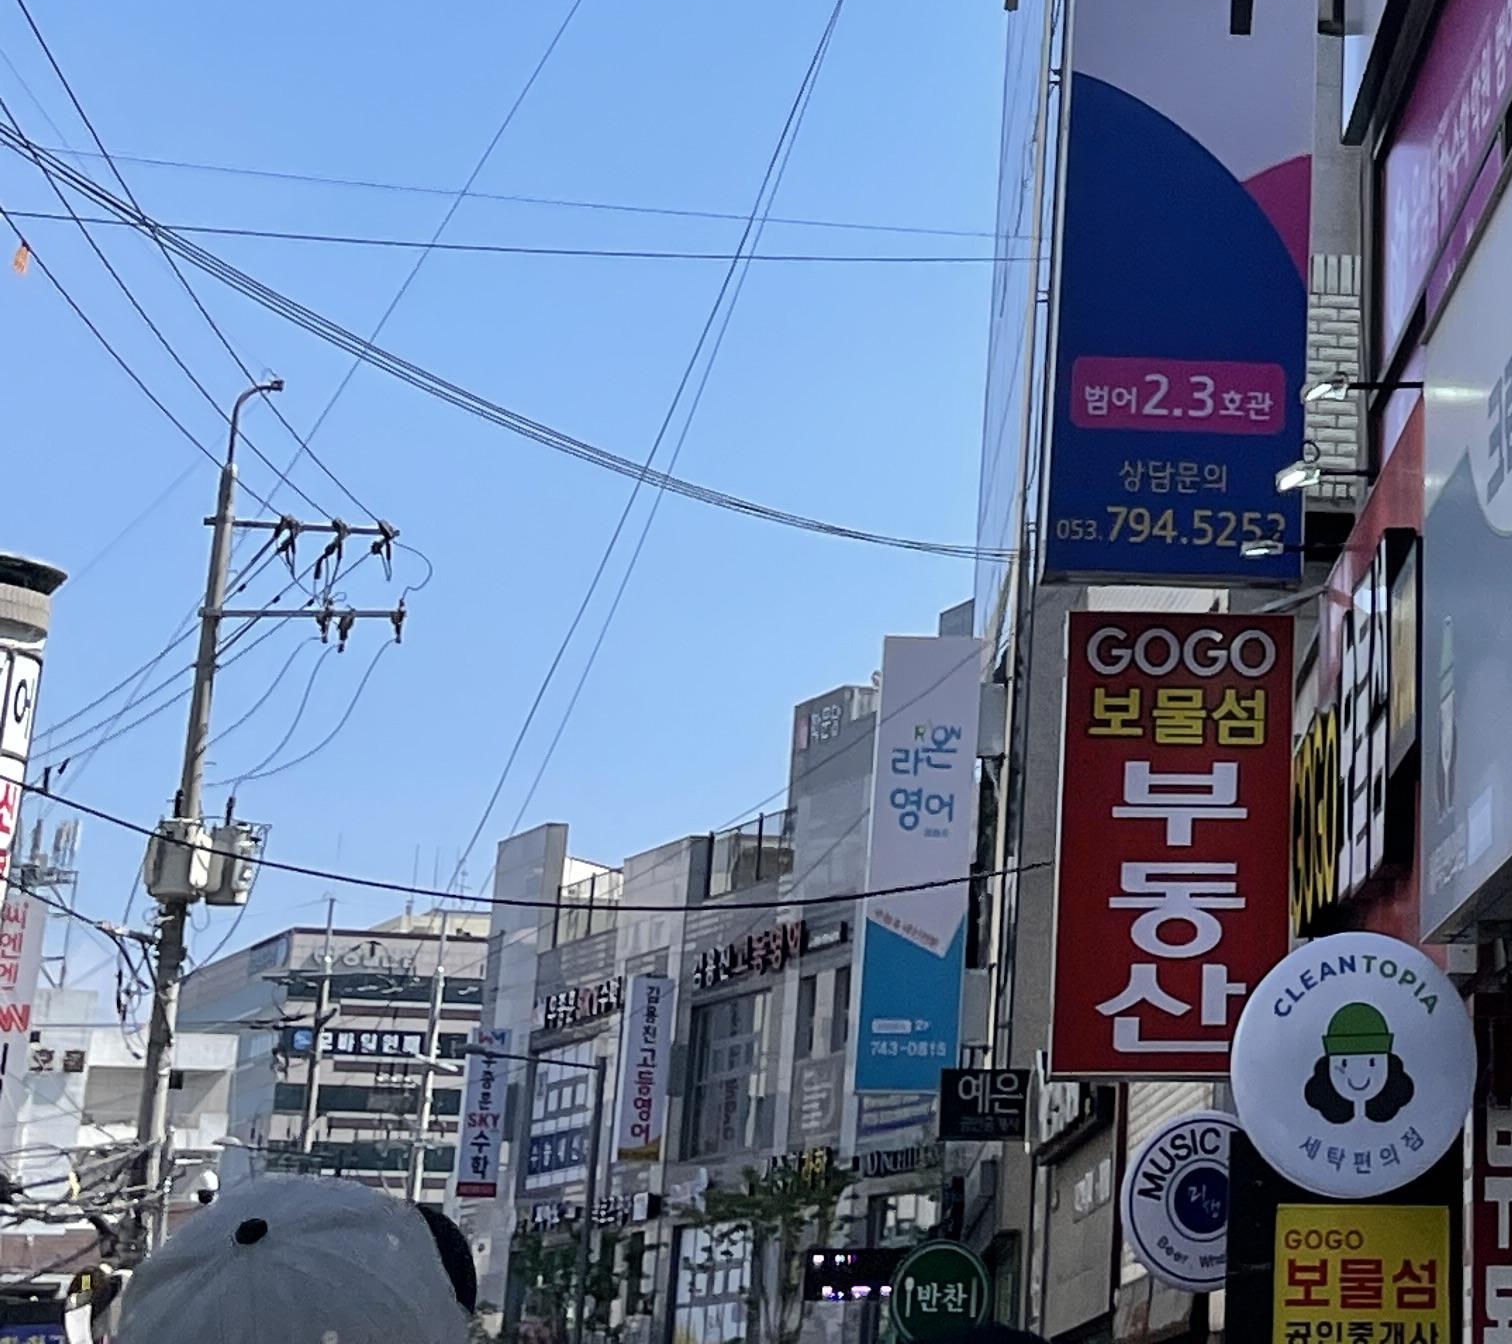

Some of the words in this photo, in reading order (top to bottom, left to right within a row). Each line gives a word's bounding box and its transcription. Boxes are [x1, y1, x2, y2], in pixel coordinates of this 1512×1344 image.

[1118, 459, 1228, 494] 상담문의
[1086, 627, 1277, 678] GOGO
[1088, 687, 1266, 746] 보물섬
[889, 787, 955, 832] 영어
[1094, 760, 1248, 1055] 부동산
[1273, 954, 1440, 1018] CLEANTOPIA
[957, 1072, 1025, 1114] 예은
[467, 1113, 500, 1129] SKY
[1137, 1127, 1222, 1202] MUSIC
[1298, 1124, 1425, 1175] 세탁편의점
[1284, 1229, 1365, 1251] GOGO
[916, 1282, 968, 1313] 반찬
[1284, 1258, 1438, 1310] 보물섬
